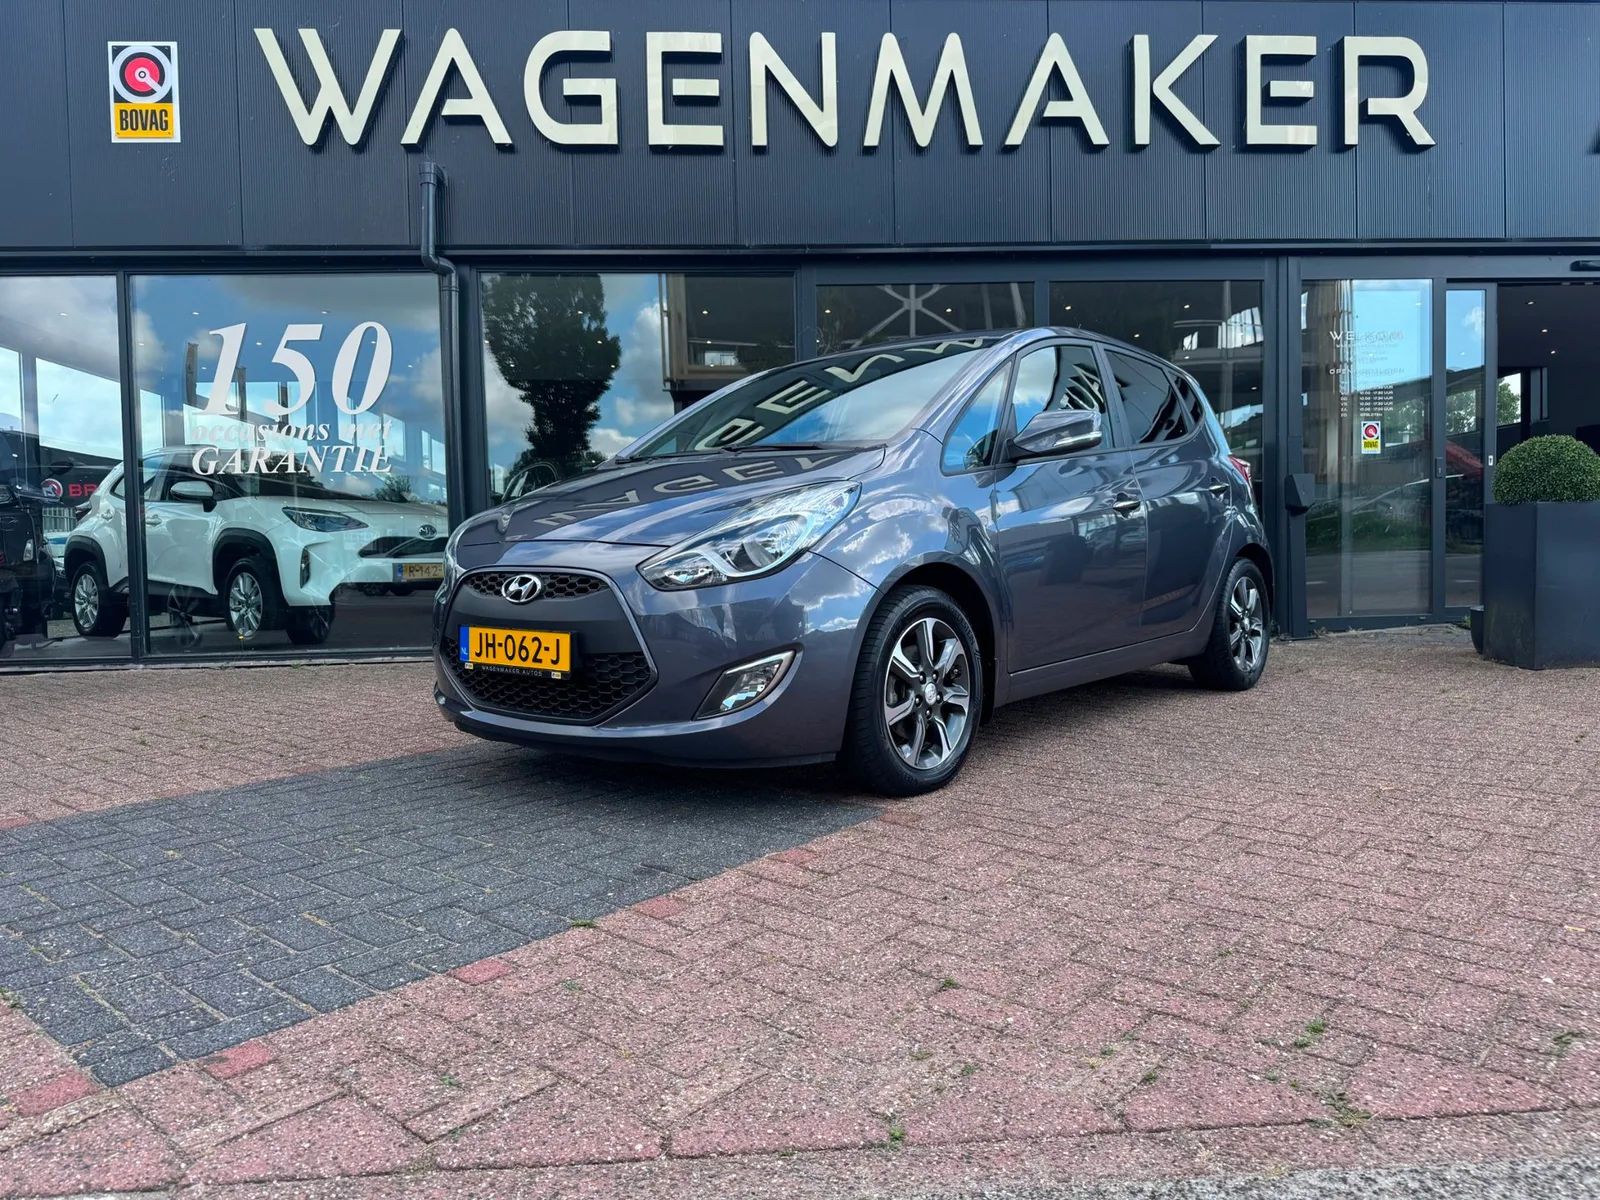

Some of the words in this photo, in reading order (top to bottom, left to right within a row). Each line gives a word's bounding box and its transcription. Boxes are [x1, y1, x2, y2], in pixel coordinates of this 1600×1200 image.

[254, 28, 1436, 148] WAGENMAKER
[119, 109, 169, 131] BOVAG
[192, 321, 393, 416] 150
[191, 416, 331, 442] occasions
[341, 418, 393, 441] met
[192, 446, 393, 476] GARANTIE
[475, 632, 560, 666] JH-062-J
[522, 669, 542, 677] AUTOS
